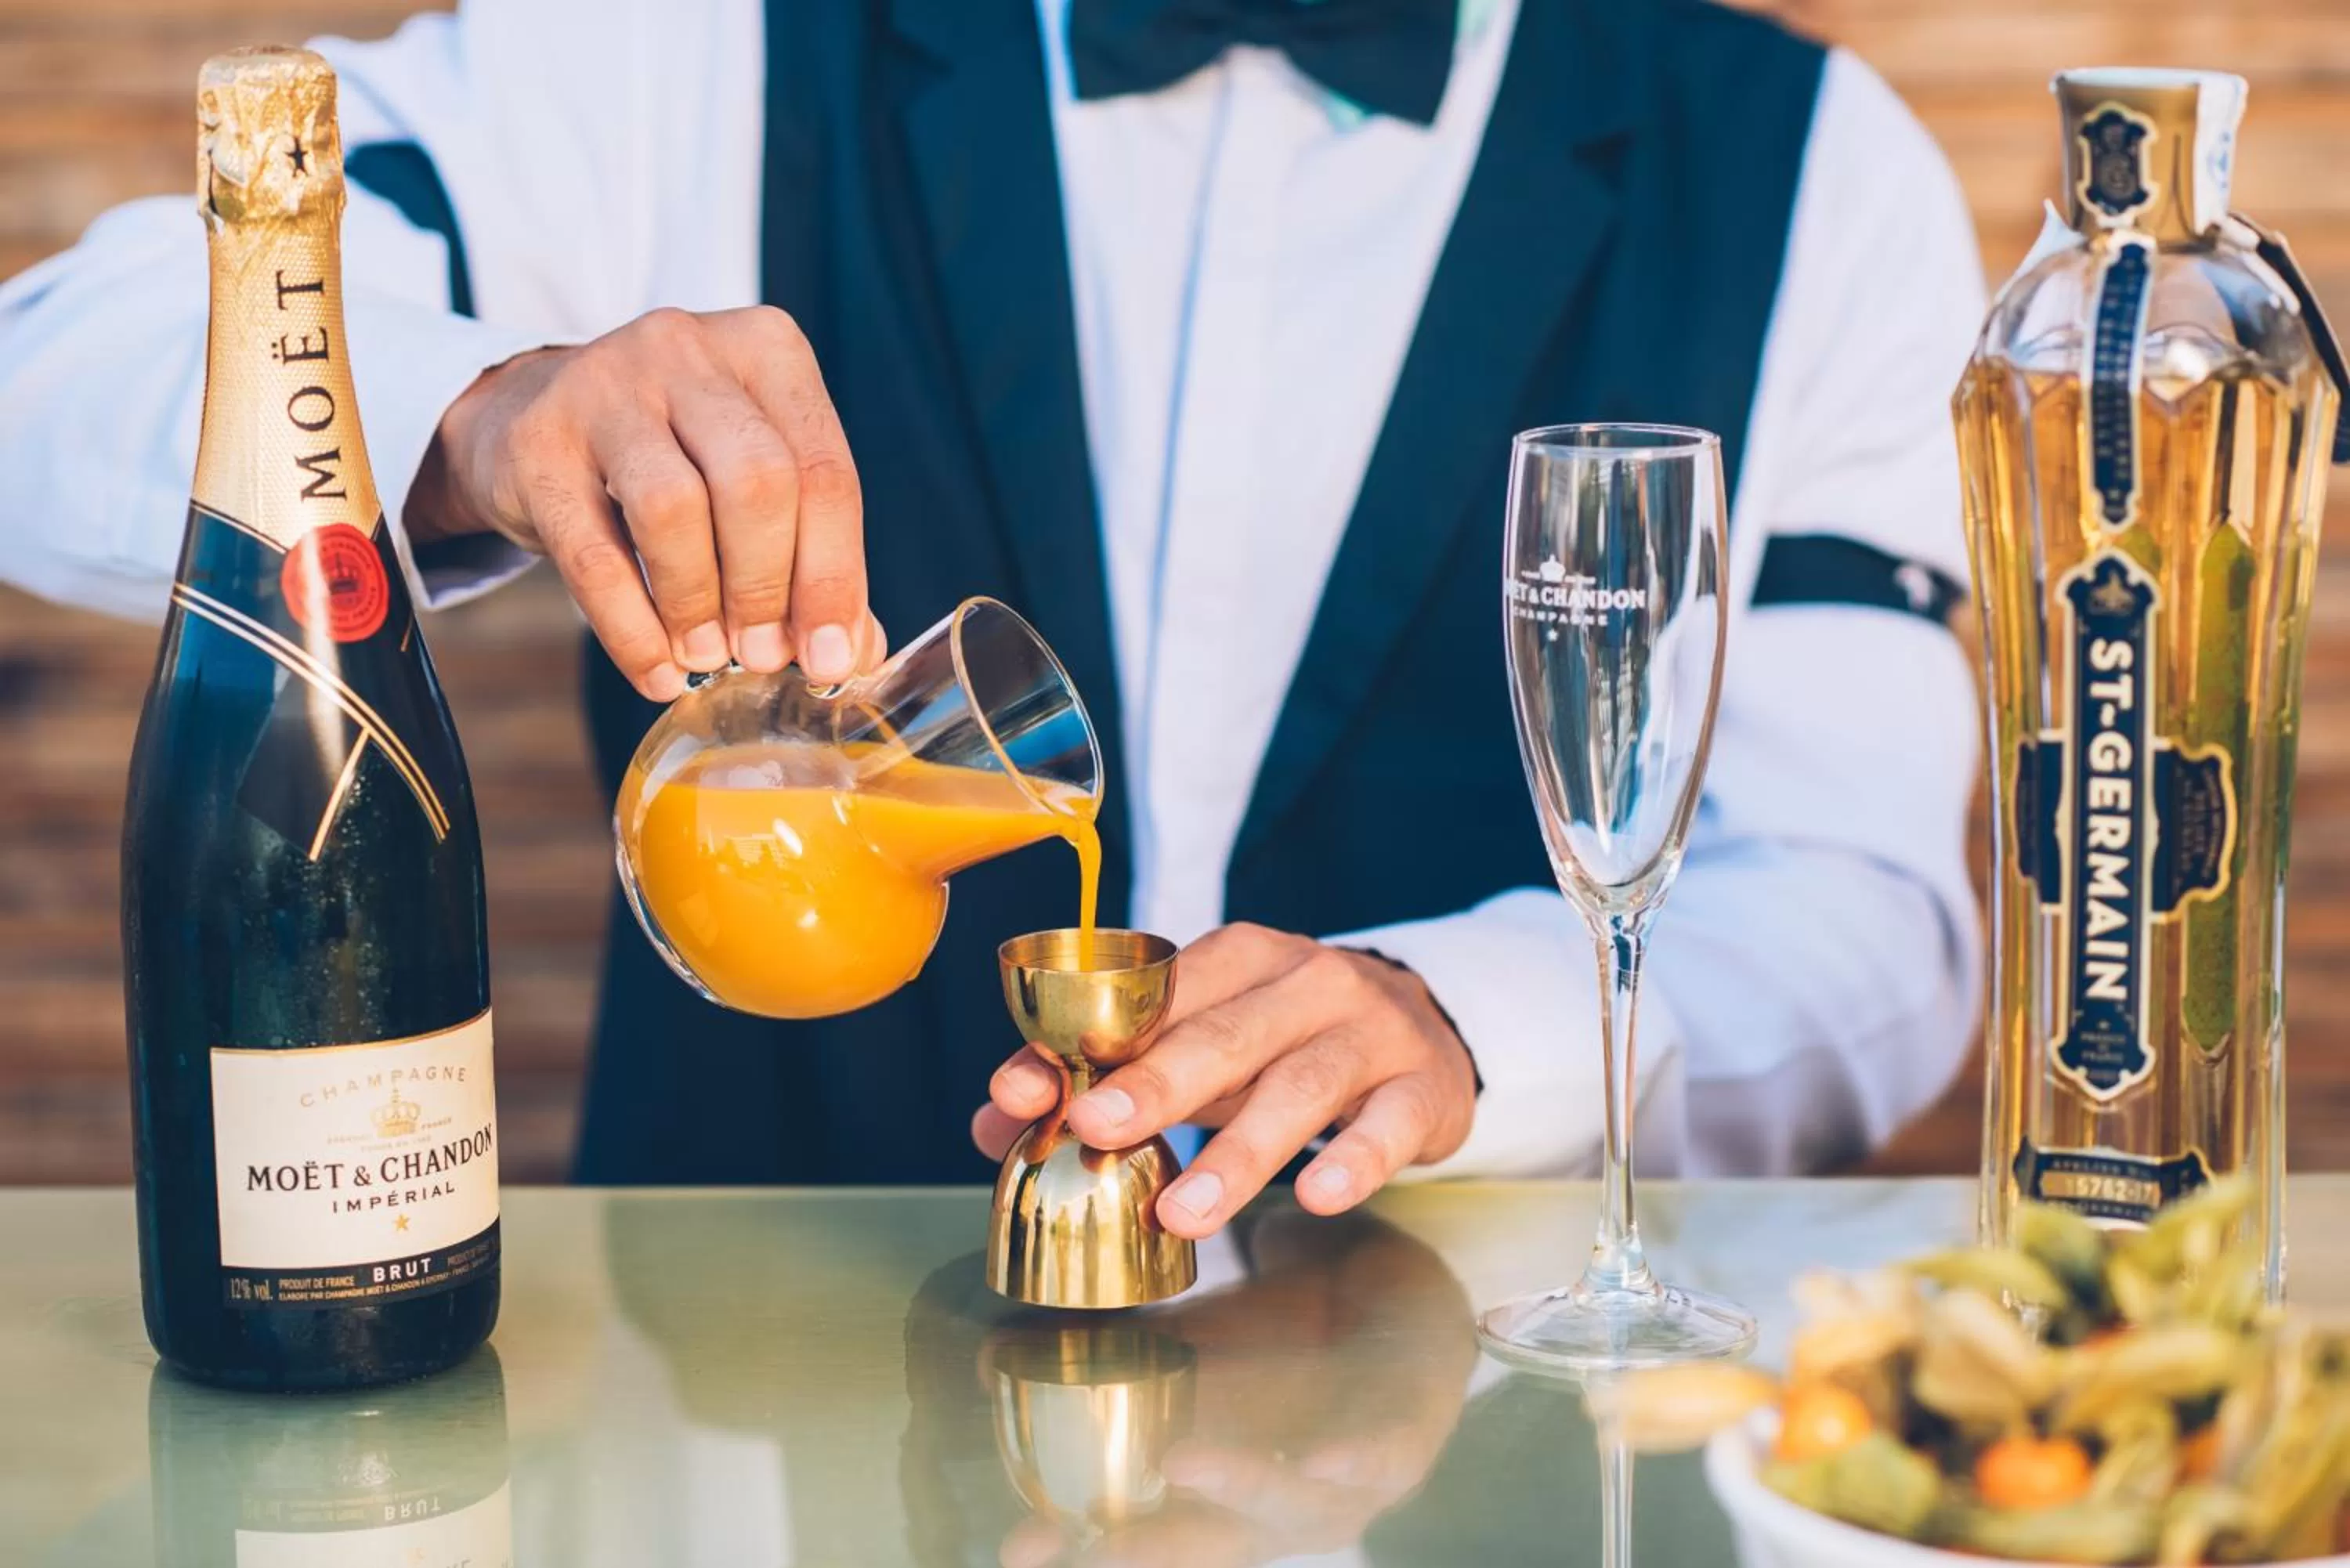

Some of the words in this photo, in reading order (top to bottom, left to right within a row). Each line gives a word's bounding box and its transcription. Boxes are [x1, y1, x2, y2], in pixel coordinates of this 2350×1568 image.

[272, 269, 347, 501] MOËT
[2084, 637, 2135, 1002] ST-GERMAIN
[300, 1065, 468, 1108] CHAMPAGNE
[246, 1161, 345, 1192] MOËT
[352, 1166, 372, 1187] &
[380, 1122, 494, 1183] CHANDON
[332, 1180, 456, 1214] IMPÉRIAL
[372, 1257, 432, 1284] BRUT
